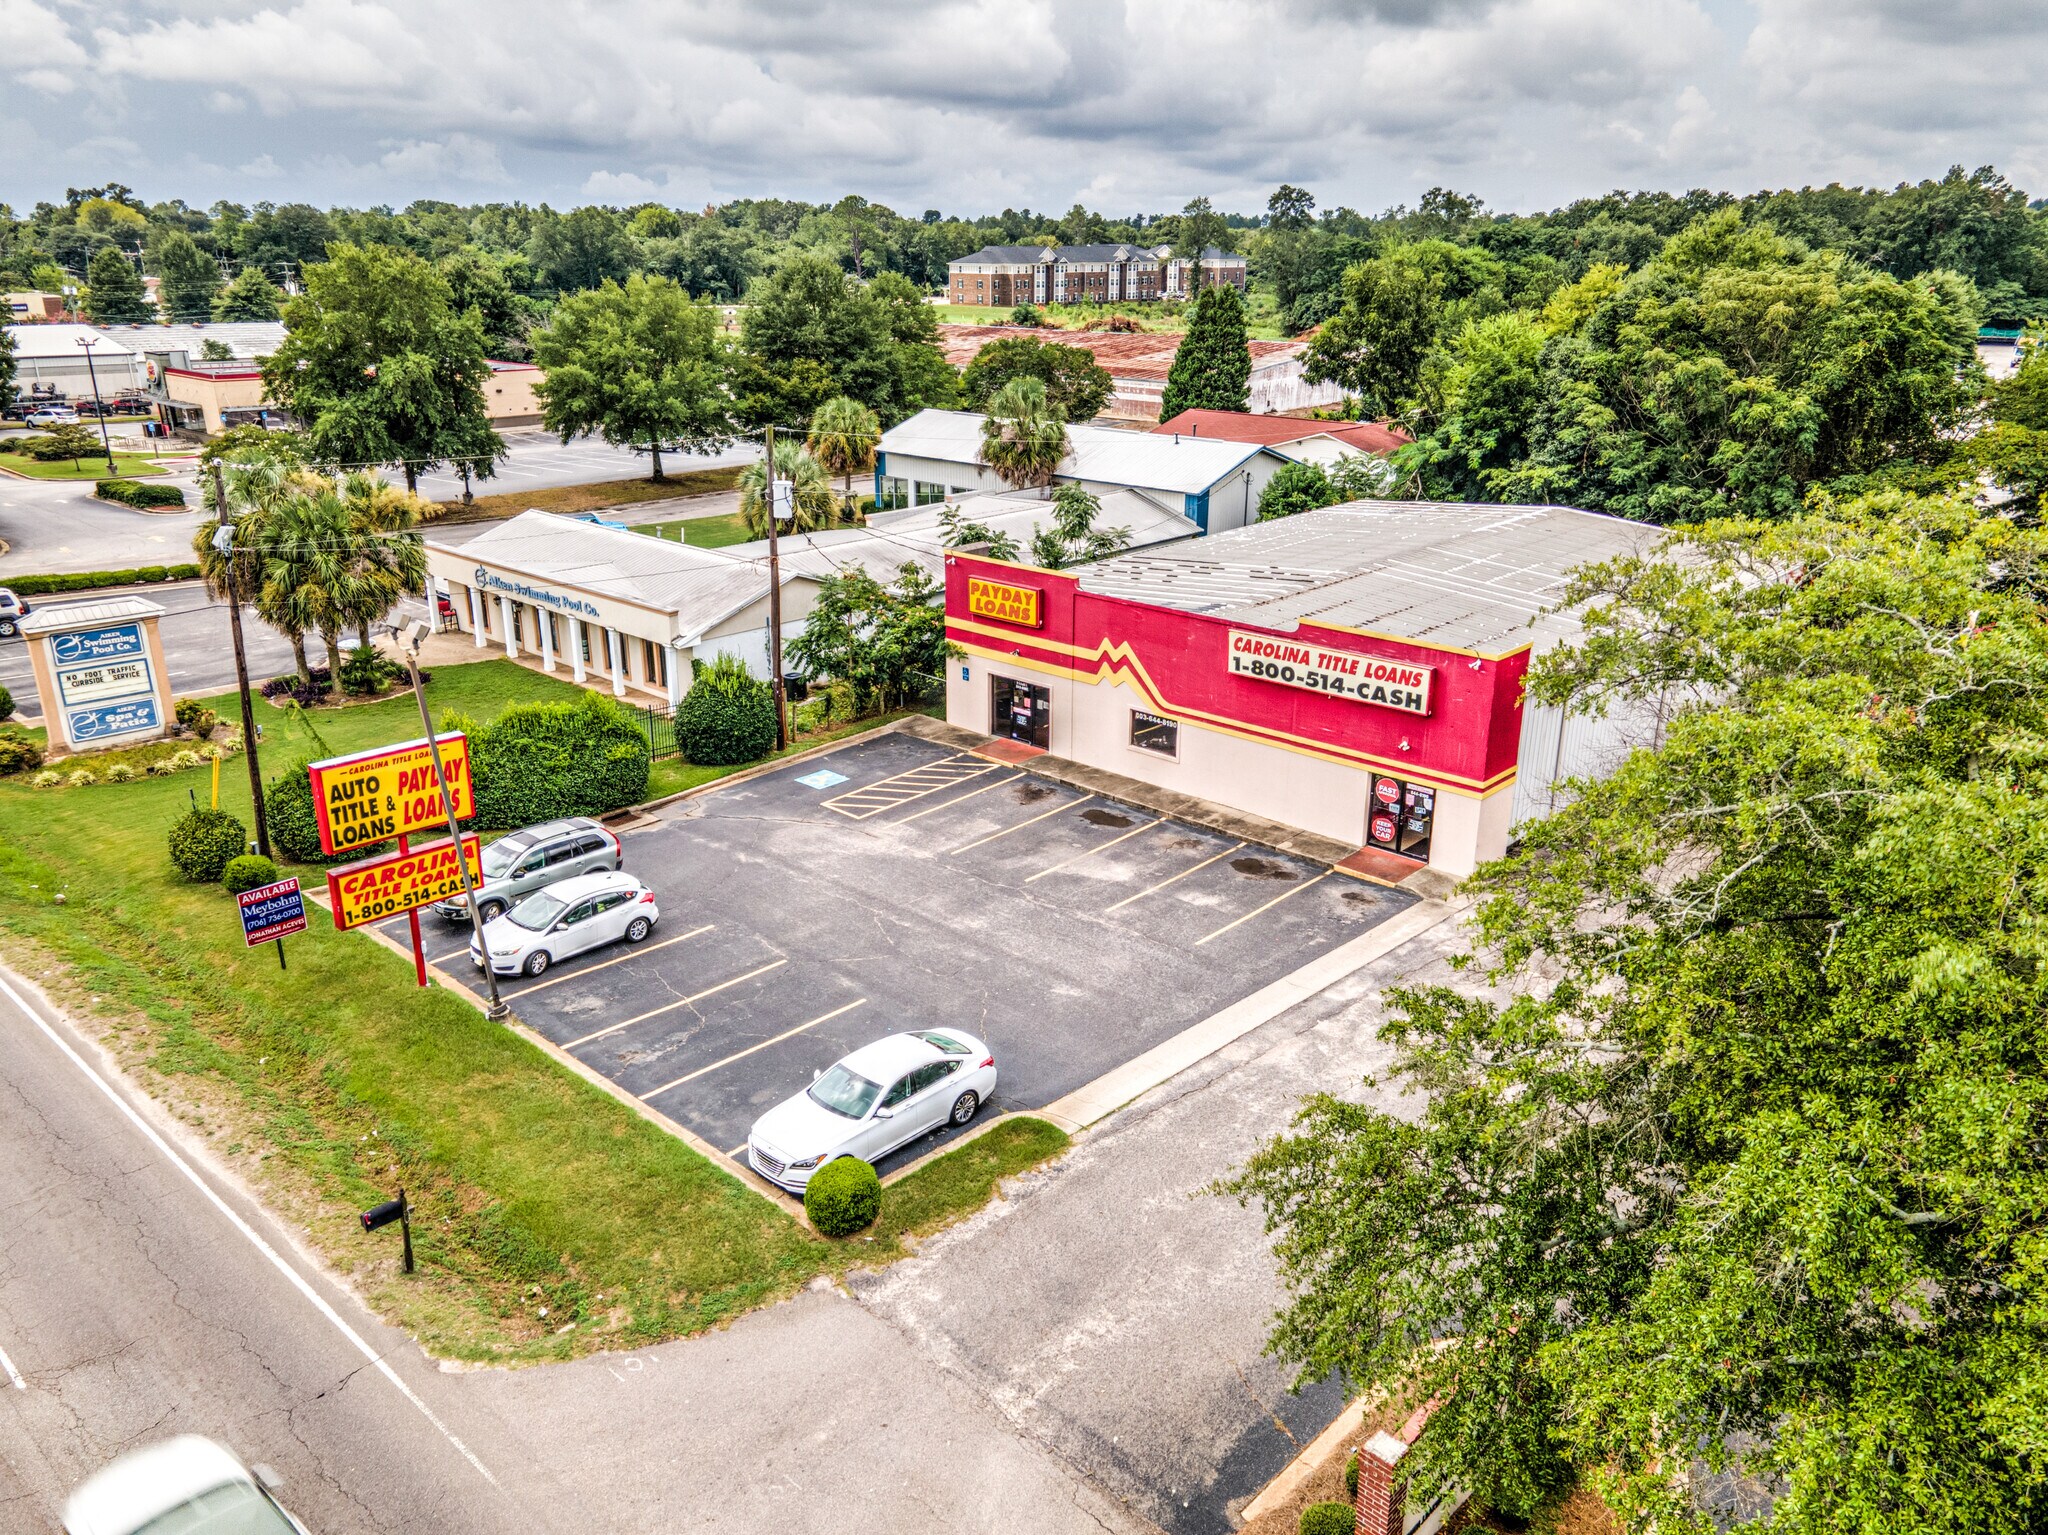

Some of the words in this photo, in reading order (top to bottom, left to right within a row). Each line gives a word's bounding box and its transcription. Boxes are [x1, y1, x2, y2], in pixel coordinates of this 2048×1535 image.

[489, 575, 513, 592] Aiken
[514, 583, 561, 608] Swimming
[562, 596, 582, 612] Pool
[584, 603, 600, 617] Co.
[971, 582, 1034, 606] PAYDAY
[975, 598, 1031, 621] LOANS
[83, 634, 137, 648] Swimming
[100, 631, 120, 639] AIKEN
[92, 646, 114, 655] Pool
[106, 665, 136, 675] TRAFFIC
[1233, 636, 1310, 666] CAROLINA
[1317, 653, 1360, 676] TITLE
[1363, 665, 1424, 688] LOANS
[71, 677, 104, 687] CURBSIDE
[112, 671, 140, 681] SERVICE
[1233, 656, 1422, 711] 1-800-514-CASH
[105, 713, 133, 723] Spa
[136, 708, 150, 716] &
[116, 705, 136, 713] AIKEN
[110, 718, 148, 730] Patio
[349, 760, 389, 775] CAROLINA
[392, 754, 412, 765] TITLE
[415, 748, 439, 760] LOA
[330, 775, 380, 804] AUTO
[1378, 785, 1397, 795] FAST
[330, 797, 379, 825] TITLE
[386, 795, 396, 812] &
[332, 816, 395, 848] LOANS
[1376, 820, 1392, 828] KEEP
[1376, 826, 1392, 834] YOUR
[1375, 831, 1391, 840] CAR
[242, 881, 296, 904] AVAILABLE
[353, 882, 402, 906] TITLE
[411, 862, 469, 890] LOAN
[243, 895, 300, 918] Meybohm
[247, 918, 267, 930] (706)
[268, 907, 301, 923] 736-0700
[248, 925, 281, 941] JONATHAN
